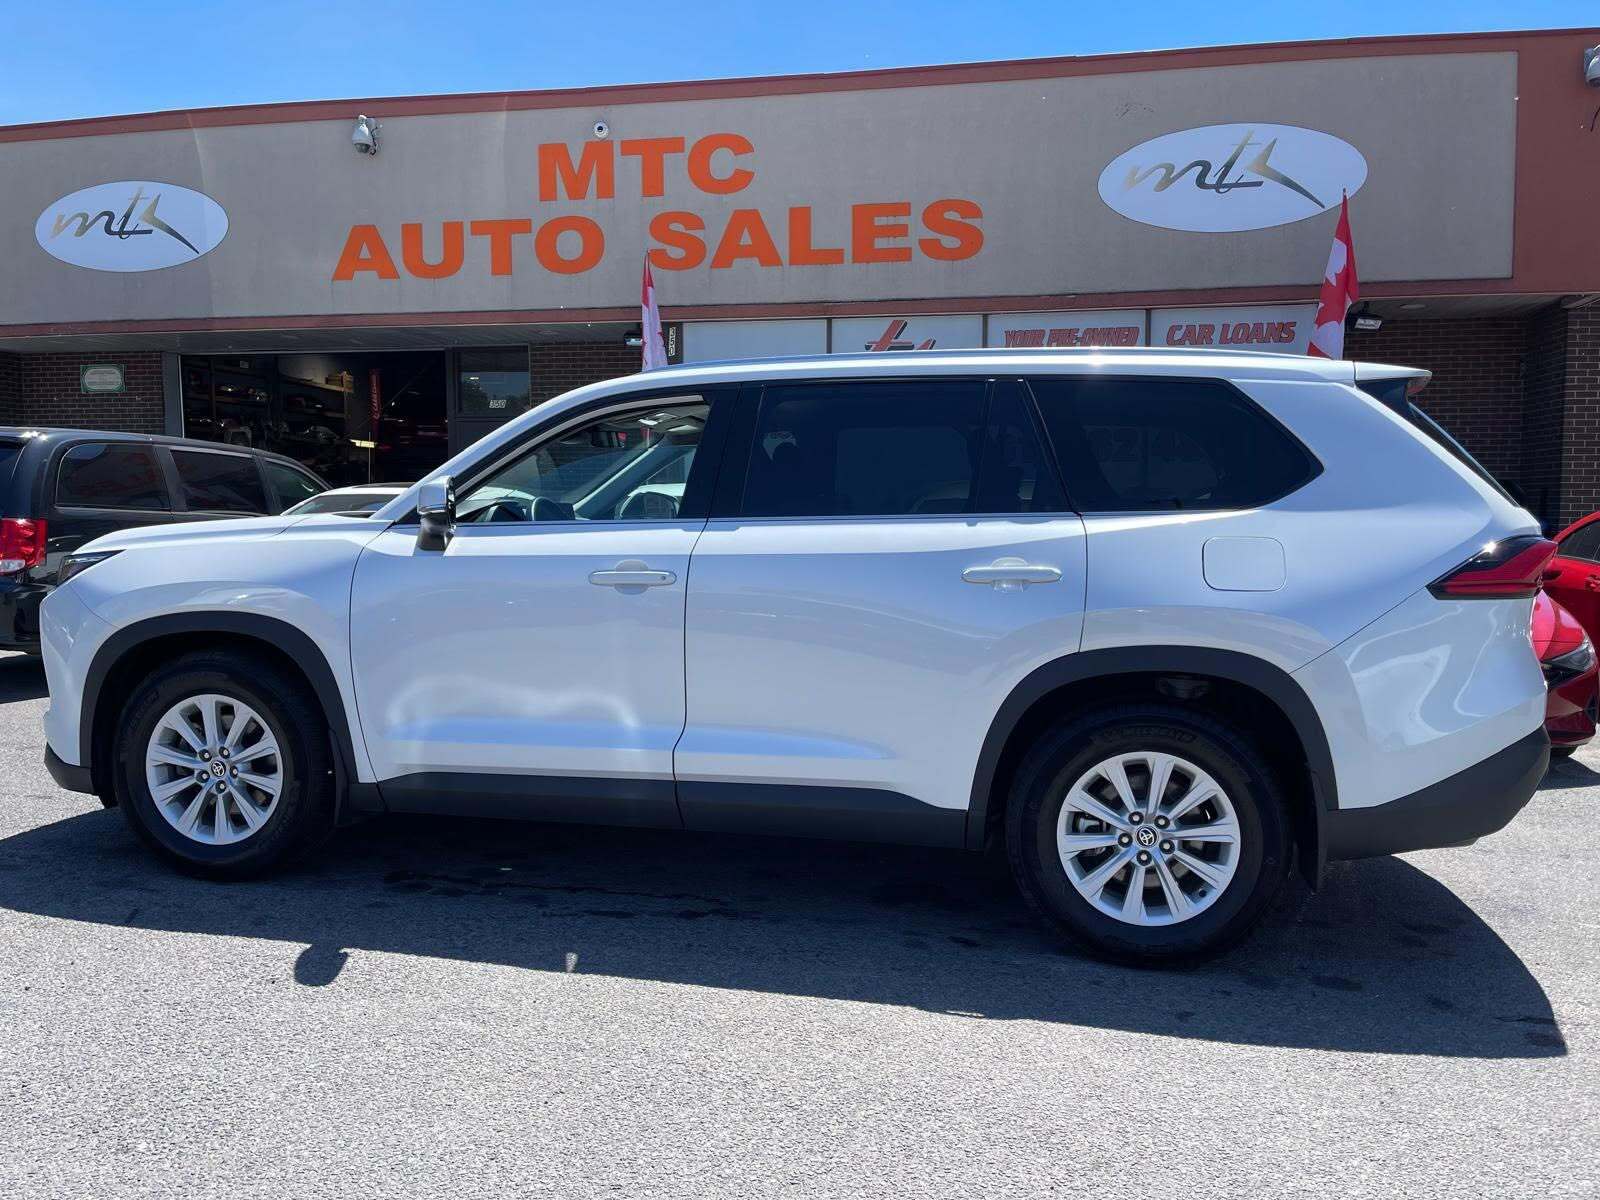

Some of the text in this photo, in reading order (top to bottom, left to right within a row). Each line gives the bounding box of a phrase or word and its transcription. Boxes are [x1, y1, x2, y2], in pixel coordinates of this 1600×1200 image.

[538, 132, 756, 202] MTC
[332, 198, 985, 282] AUTO SALES
[1165, 320, 1298, 346] CAR LOANS
